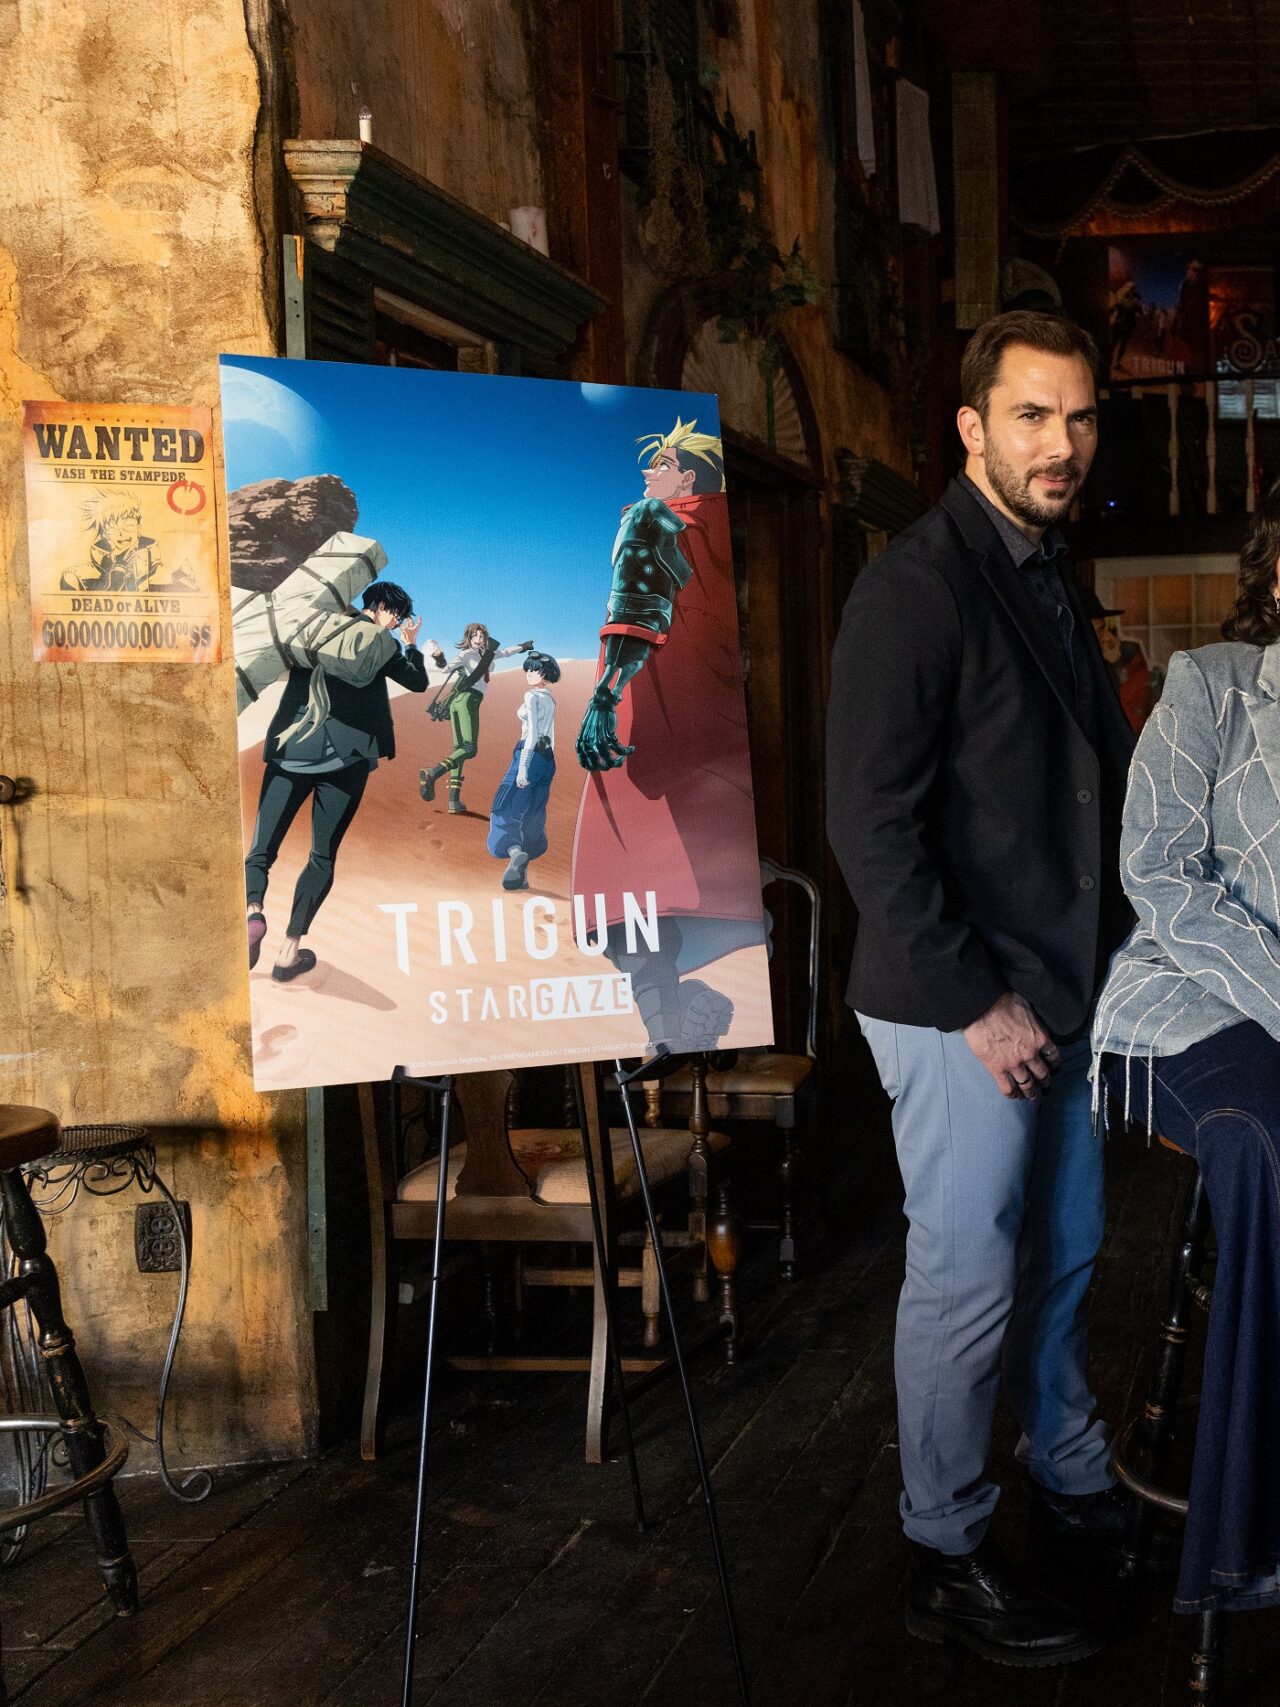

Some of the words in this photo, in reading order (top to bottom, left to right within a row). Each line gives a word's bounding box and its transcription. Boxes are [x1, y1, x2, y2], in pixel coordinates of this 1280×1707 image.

[1132, 356, 1186, 376] TRIGUN
[33, 423, 205, 464] WANTED
[54, 468, 86, 480] VASH
[90, 469, 116, 481] THE
[120, 470, 186, 482] STAMPEDE
[71, 598, 114, 613] DEAD
[117, 601, 131, 613] or
[134, 599, 180, 613] ALIVE
[376, 890, 660, 976] TRIGUN
[428, 976, 631, 1024] STARGAZE
